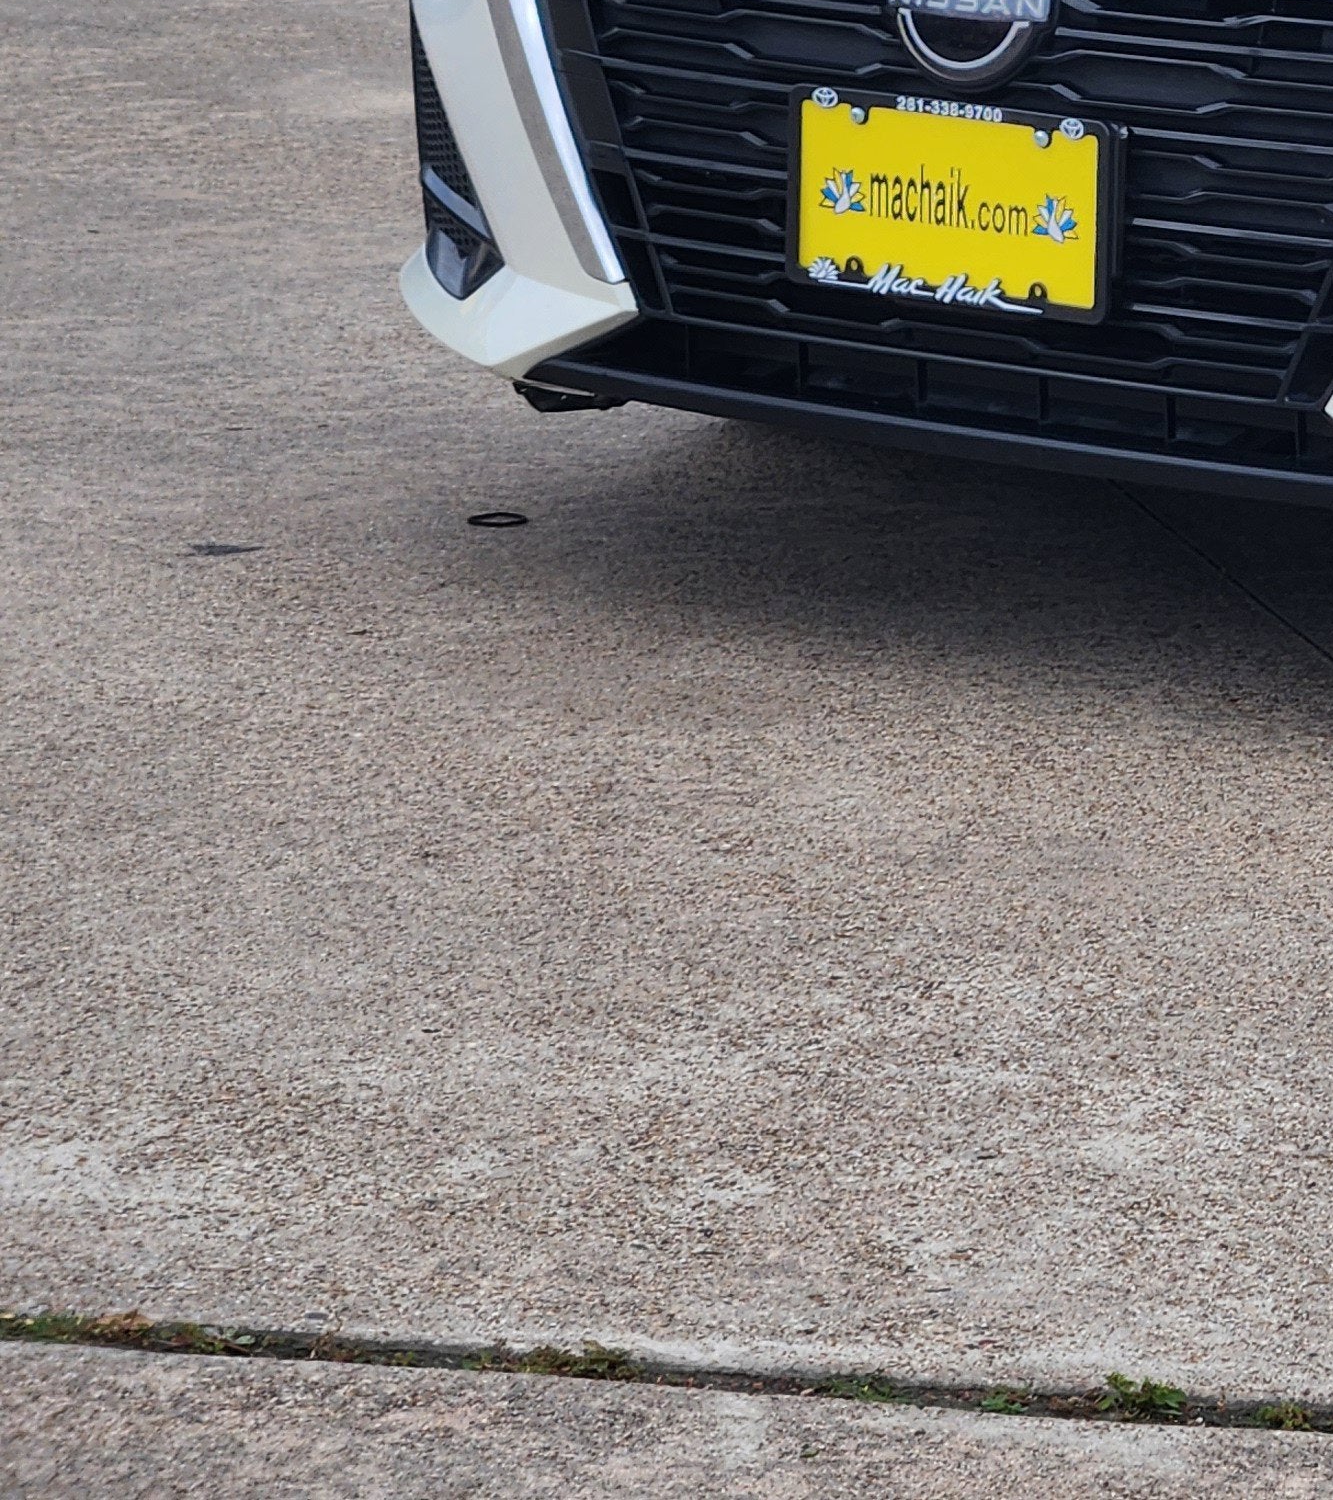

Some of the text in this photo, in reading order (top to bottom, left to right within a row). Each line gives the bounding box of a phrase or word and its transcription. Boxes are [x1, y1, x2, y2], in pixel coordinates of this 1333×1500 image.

[896, 95, 1003, 123] 281-338-9700
[869, 163, 1030, 237] machaik.com
[867, 262, 935, 297] Mac
